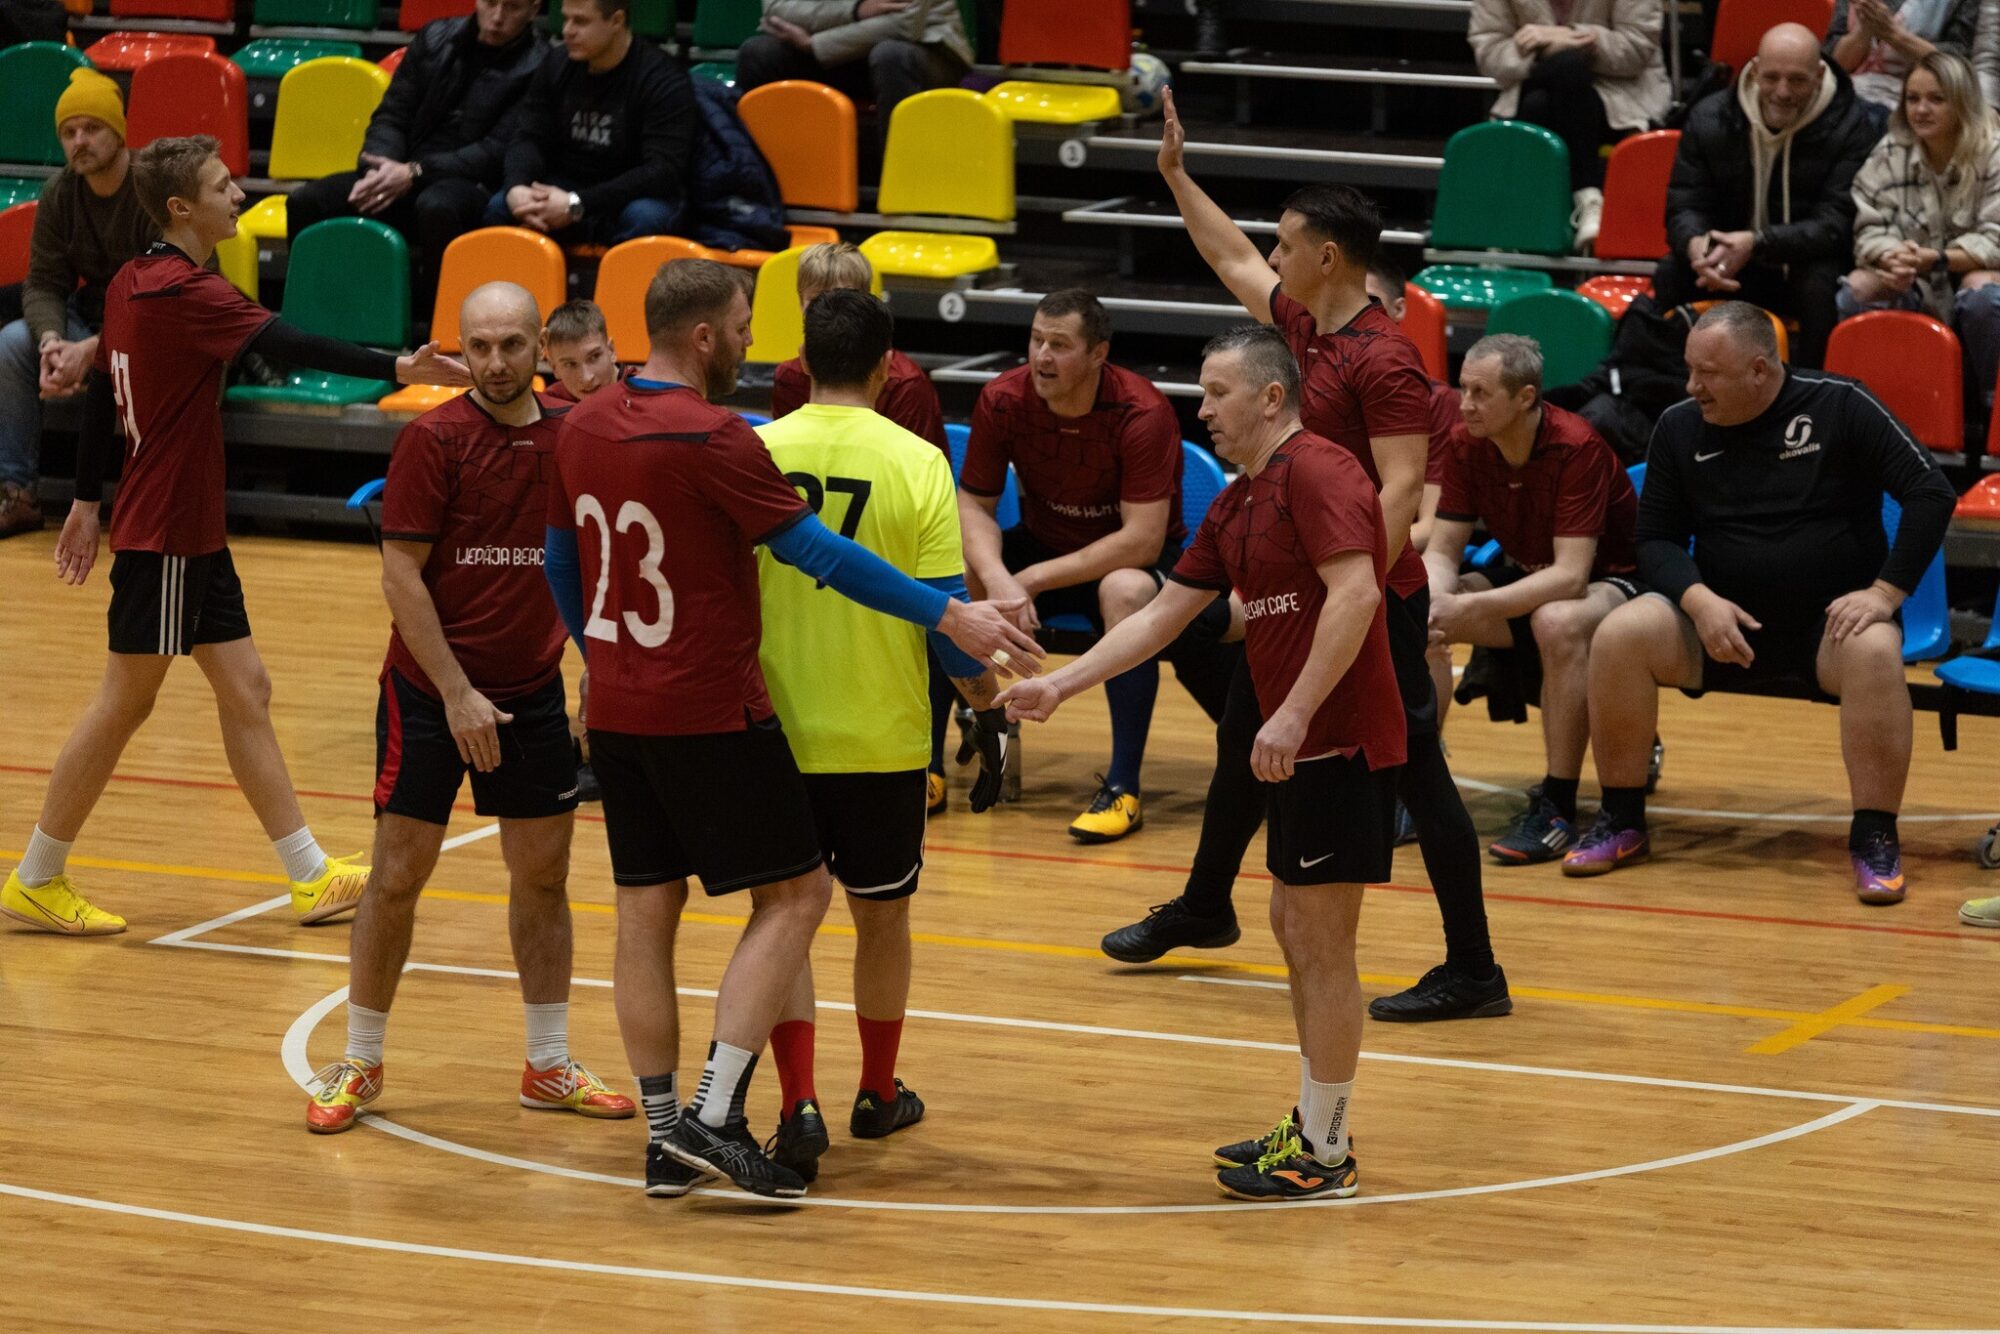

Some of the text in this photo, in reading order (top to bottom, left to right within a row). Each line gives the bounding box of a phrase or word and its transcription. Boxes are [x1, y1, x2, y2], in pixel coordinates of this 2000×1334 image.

[571, 125, 611, 146] MAX
[575, 493, 675, 648] 23
[1267, 592, 1300, 615] CAFE
